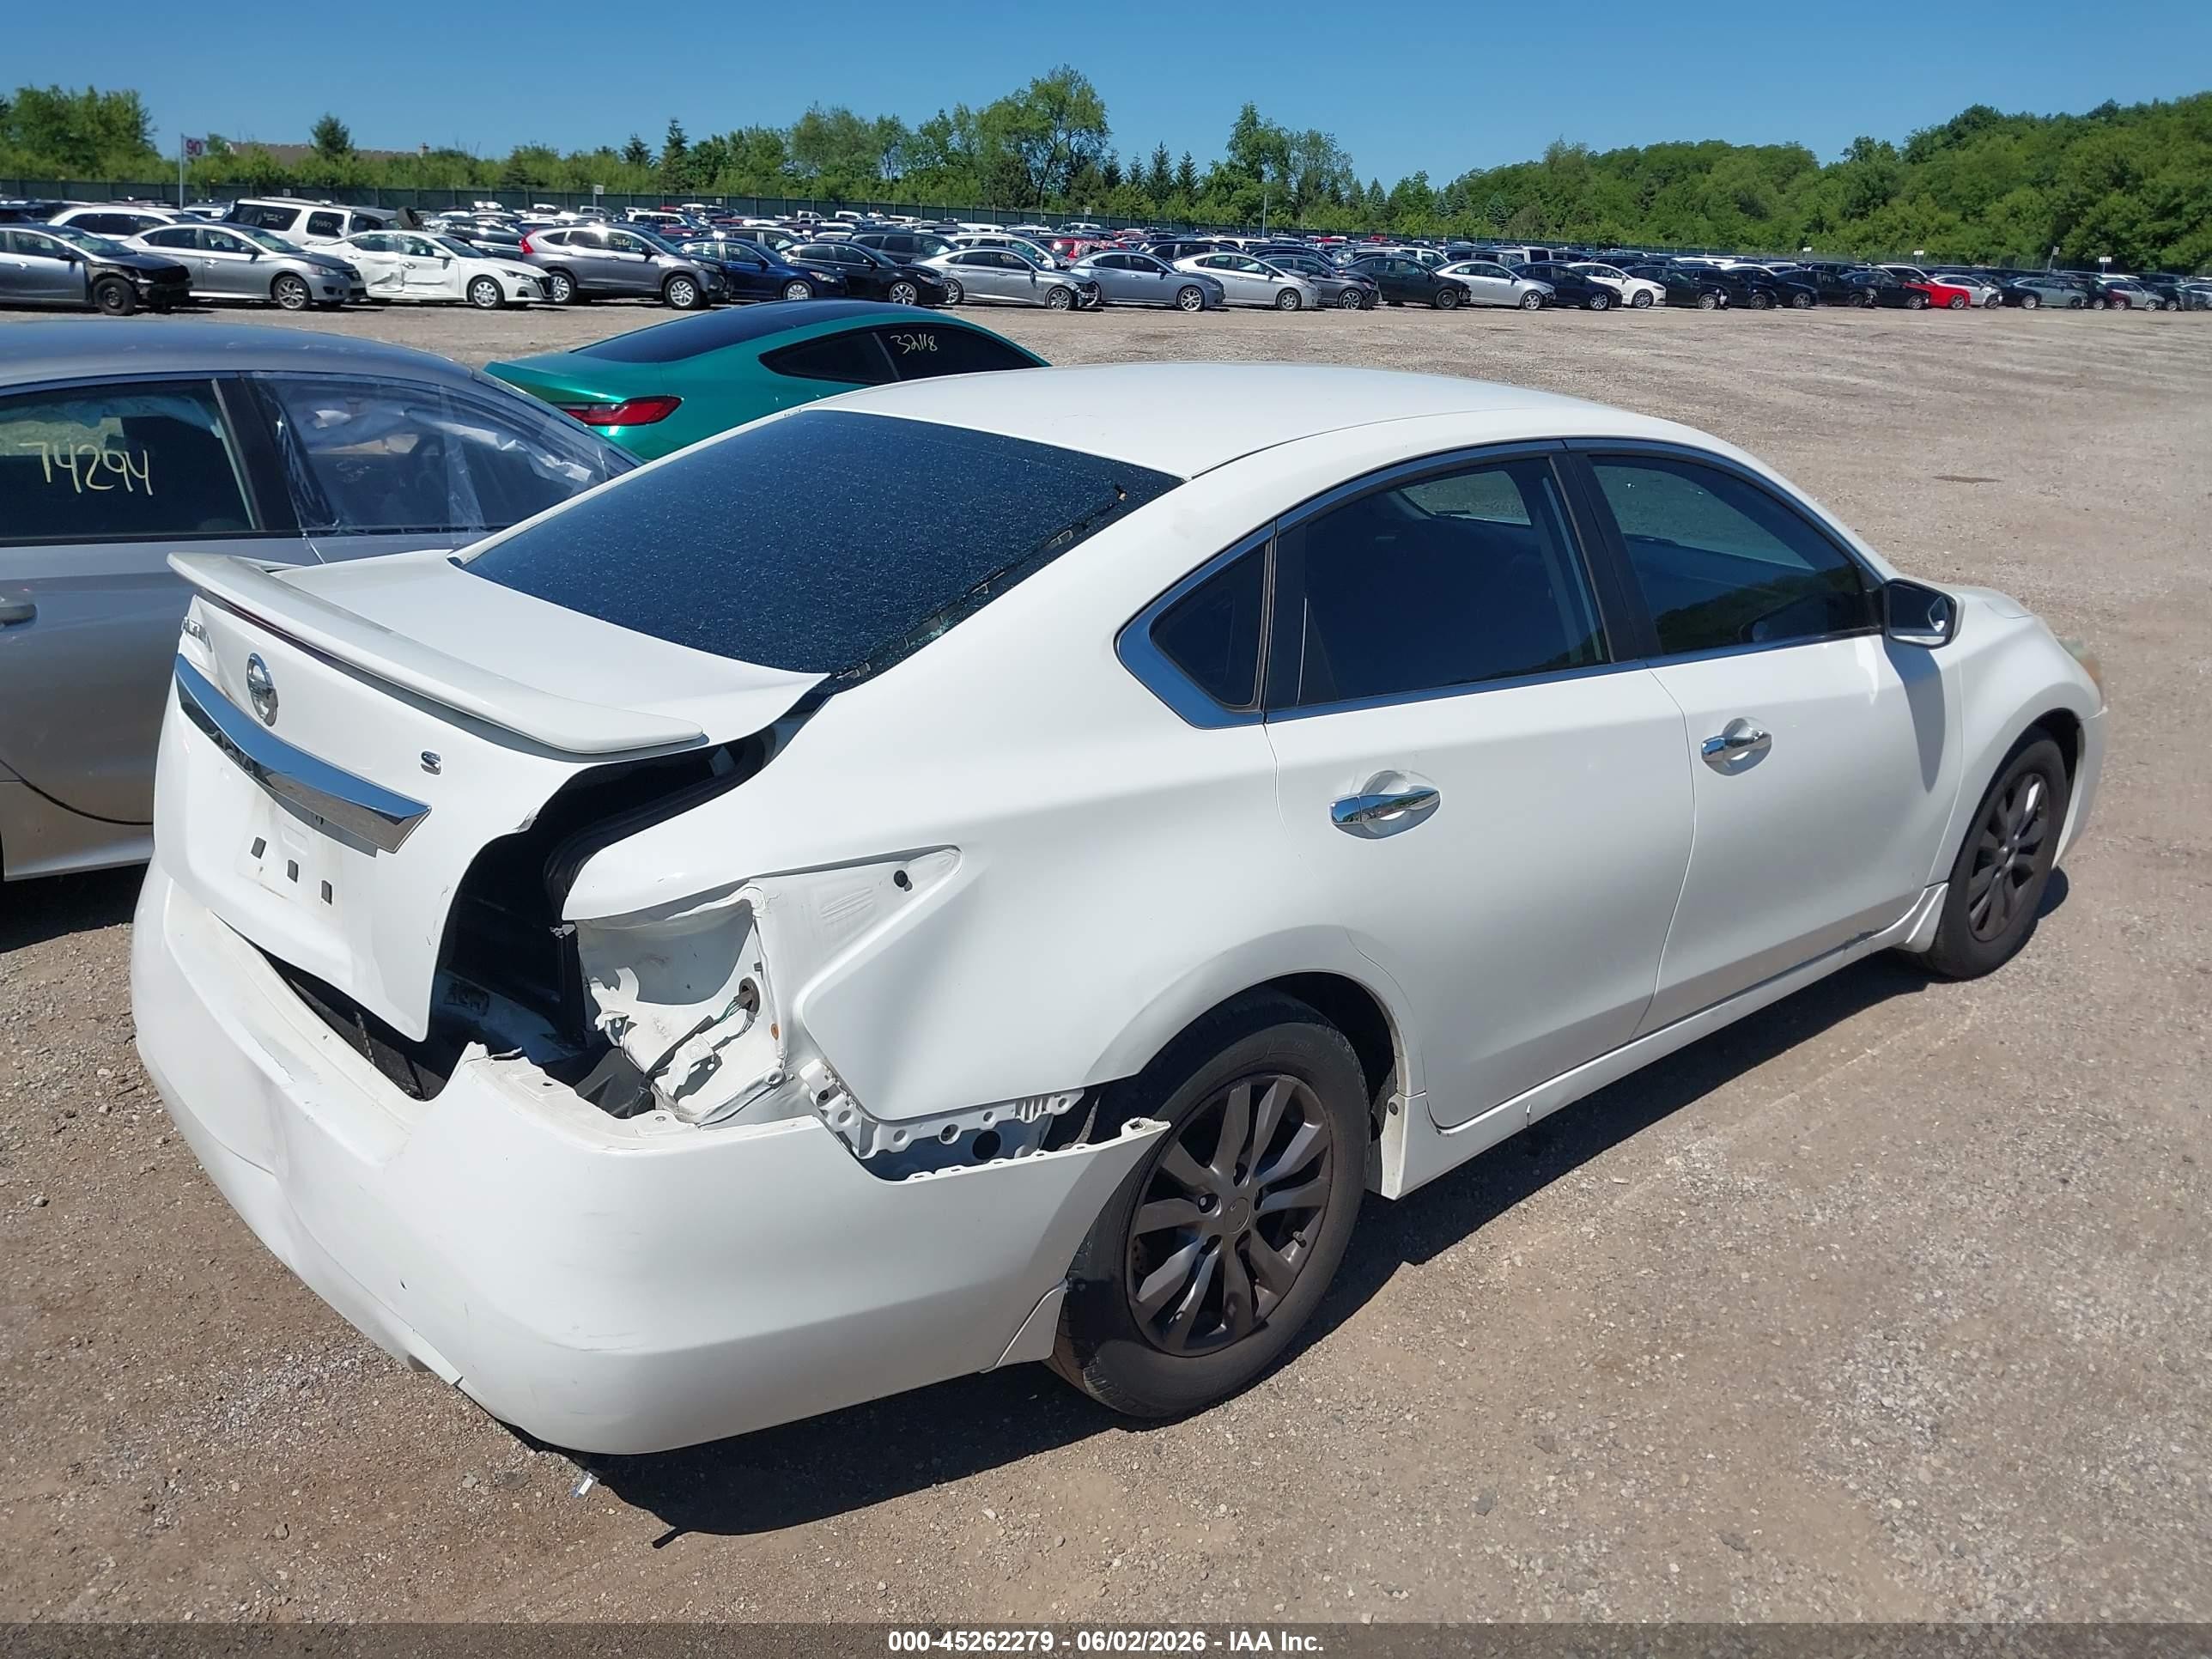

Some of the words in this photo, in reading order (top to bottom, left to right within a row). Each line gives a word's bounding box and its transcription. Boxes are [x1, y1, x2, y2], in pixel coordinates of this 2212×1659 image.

[185, 138, 203, 156] 90
[890, 333, 939, 355] 32118
[18, 442, 154, 495] 74294
[420, 750, 441, 775] S
